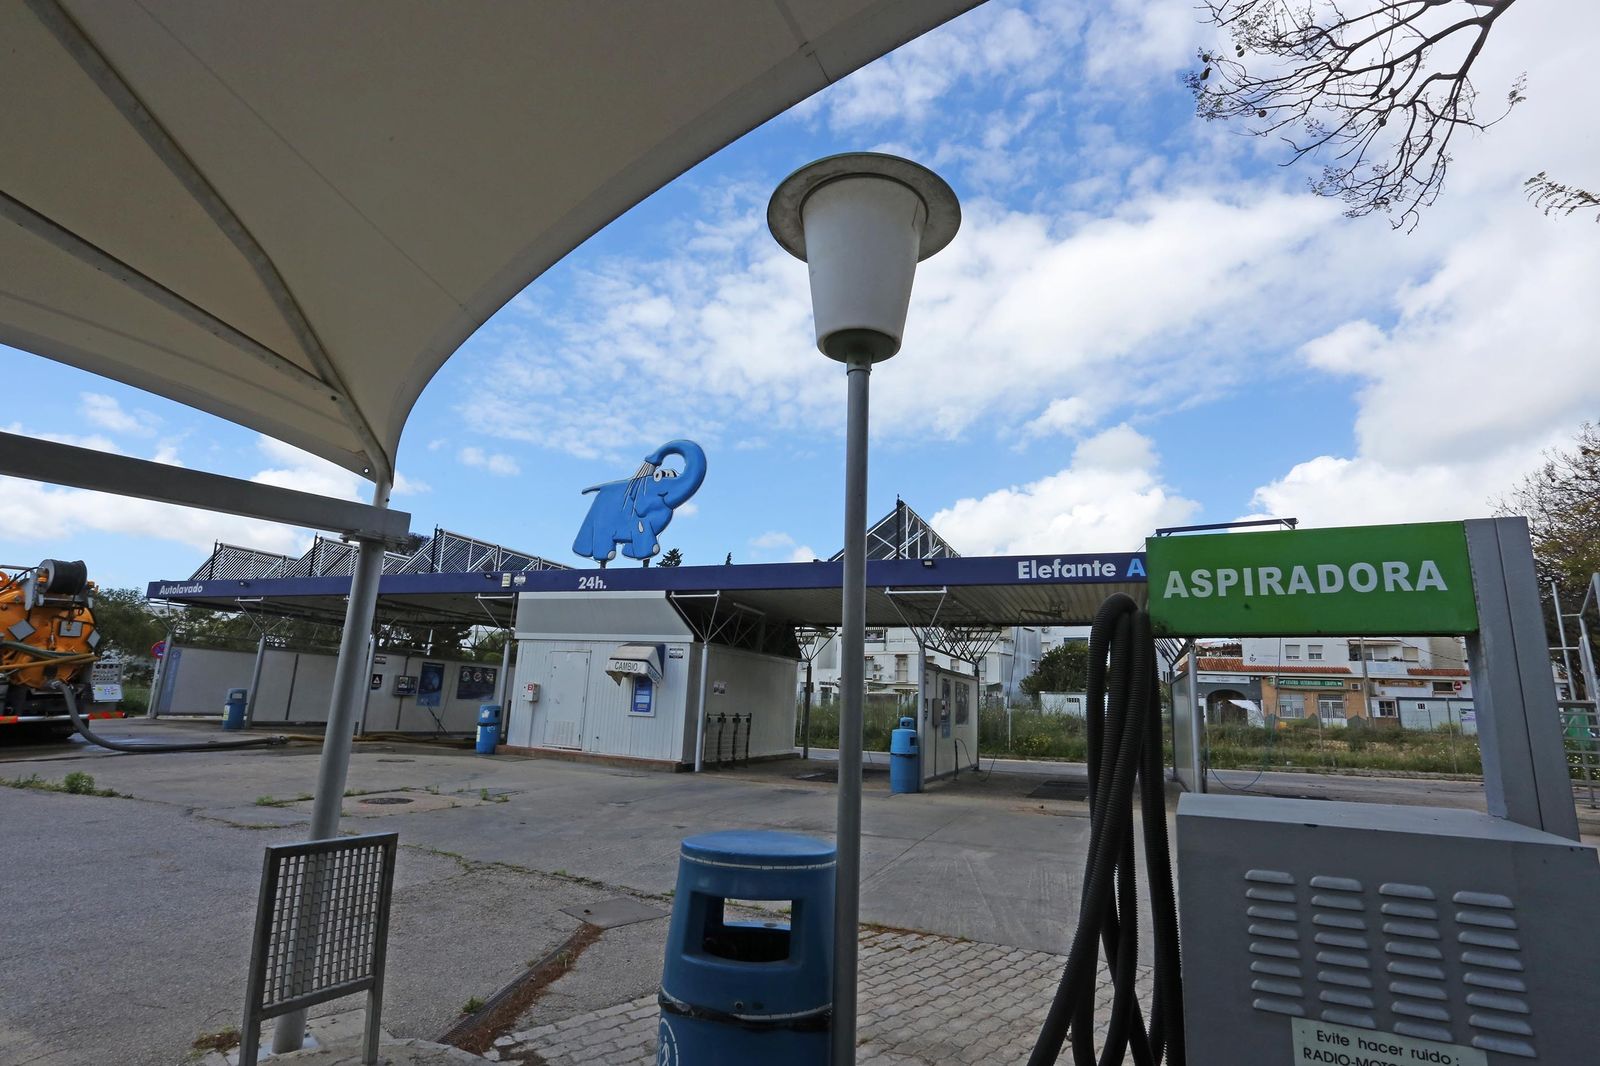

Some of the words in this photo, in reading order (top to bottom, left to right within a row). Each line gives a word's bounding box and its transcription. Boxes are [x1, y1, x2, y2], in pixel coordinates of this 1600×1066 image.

[1017, 558, 1116, 580] Elefante
[578, 576, 607, 590] 24h.
[1163, 560, 1448, 598] ASPIRADORA
[159, 582, 203, 595] Autolavado
[614, 660, 638, 672] CAMBIO
[1316, 1029, 1350, 1046] Evite
[1358, 1037, 1403, 1056] hacer
